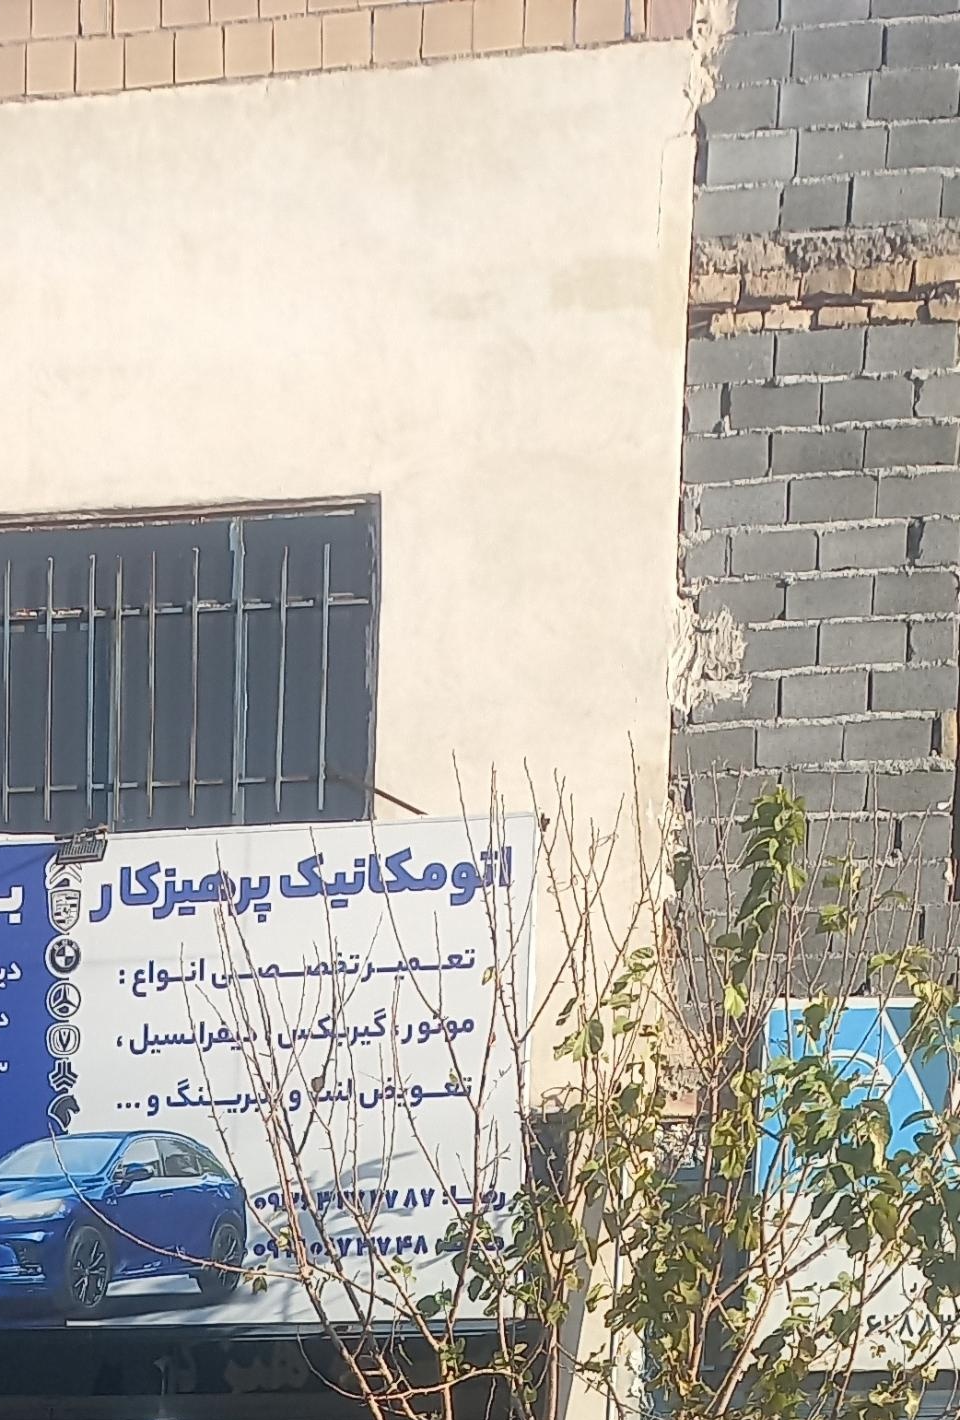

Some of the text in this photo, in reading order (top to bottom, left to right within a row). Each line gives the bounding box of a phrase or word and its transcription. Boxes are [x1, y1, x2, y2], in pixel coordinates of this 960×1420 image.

[89, 861, 272, 924] پرهیزکار
[132, 958, 205, 997] انواع
[147, 1094, 160, 1116] و
